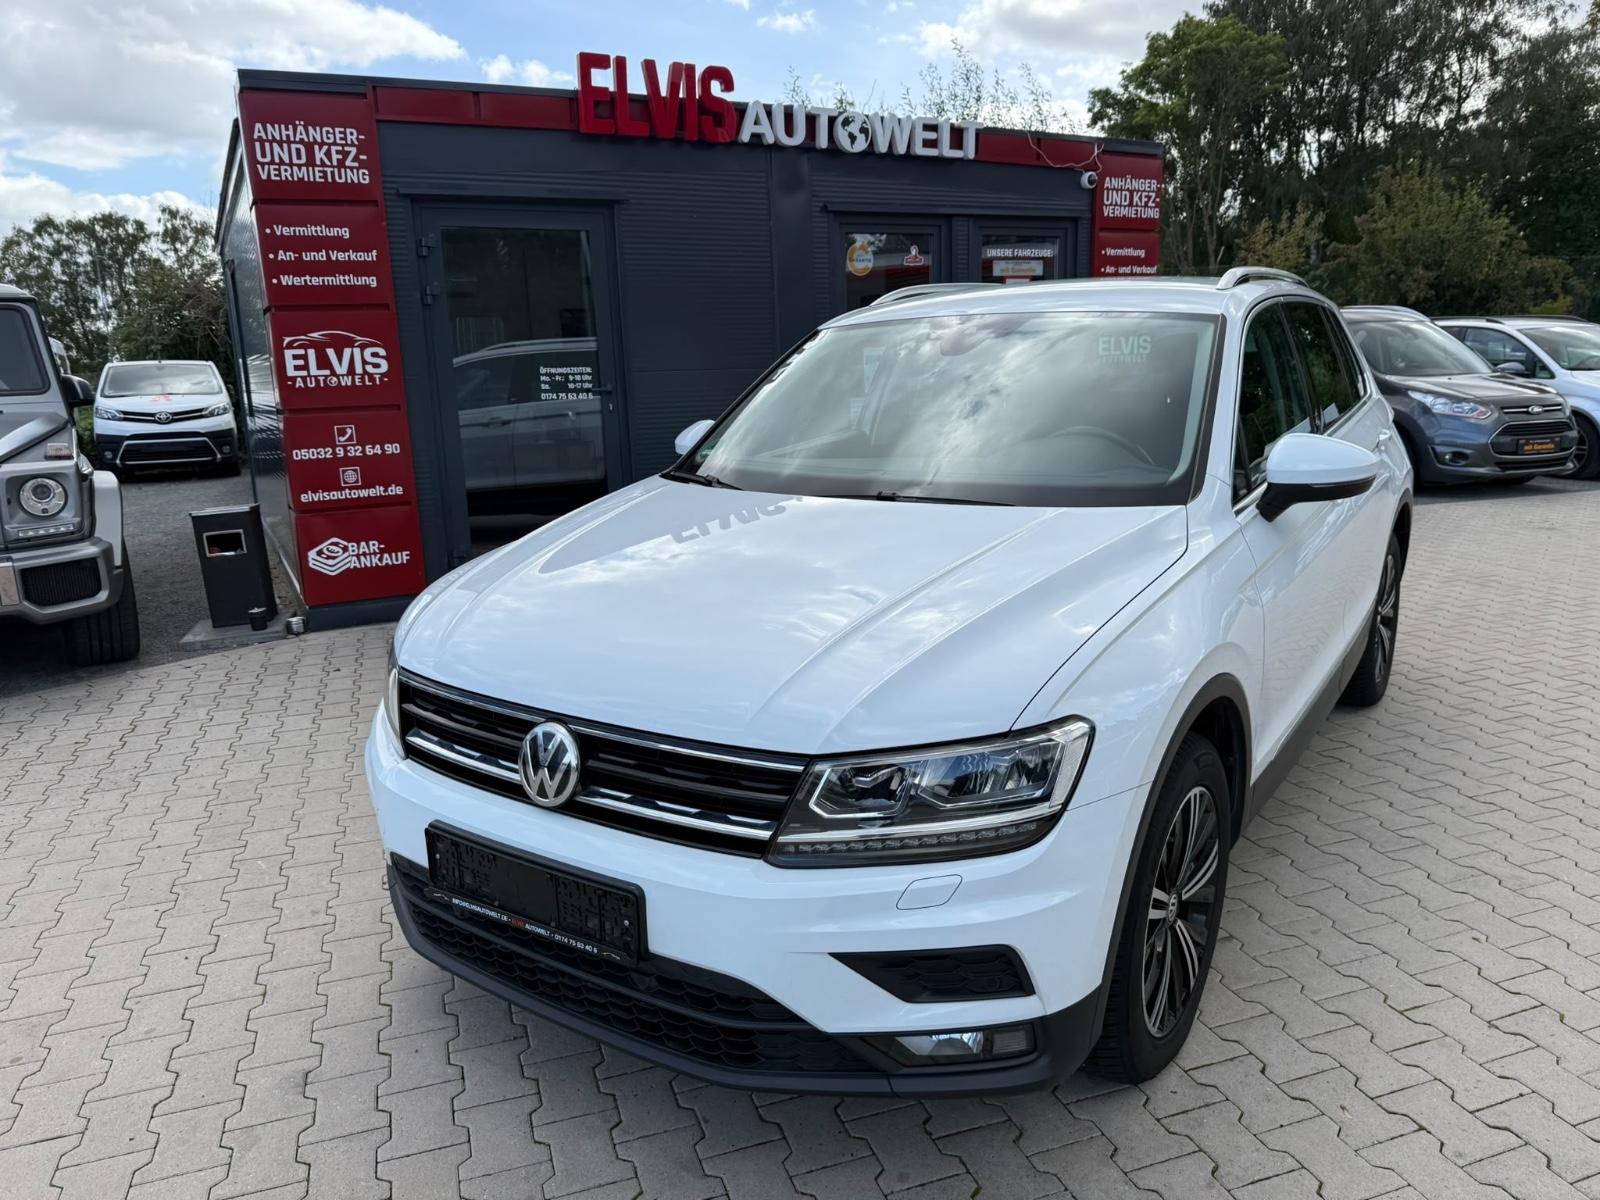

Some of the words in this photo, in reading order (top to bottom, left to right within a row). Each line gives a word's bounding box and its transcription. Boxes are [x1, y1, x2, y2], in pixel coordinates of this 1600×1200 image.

[577, 51, 737, 143] ELVIS
[253, 120, 366, 145] ANHÄNGER-
[255, 142, 307, 164] UND
[314, 145, 368, 167] KFZ-
[257, 164, 370, 184] VERMIETUNG
[1103, 175, 1160, 191] ANHÄNGER-
[1103, 190, 1129, 205] UND
[1133, 191, 1160, 207] KFZ-
[1103, 205, 1160, 219] VERMIETUNG
[273, 224, 350, 239] Vermittlung
[277, 250, 299, 261] An-
[302, 249, 327, 261] und
[329, 249, 378, 261] Verkauf
[986, 248, 1013, 257] UNSERE
[1106, 247, 1145, 258] Vermittlung
[1105, 265, 1117, 273] An-
[1118, 265, 1131, 273] und
[1132, 265, 1158, 273] Verkauf
[280, 274, 378, 288] Wertermittlung
[1098, 335, 1152, 355] ELVIS
[283, 346, 389, 377] ELVIS
[541, 392, 557, 400] 0174
[558, 392, 566, 400] 75
[578, 392, 587, 400] 40
[292, 446, 333, 461] 05032
[335, 446, 345, 458] 9
[347, 446, 363, 458] 32
[365, 444, 382, 456] 64
[384, 443, 400, 455] 90
[300, 484, 404, 503] elvisautowelt.de
[349, 540, 385, 555] BAR-
[349, 551, 411, 569] ANKAUF
[521, 724, 579, 805] VW
[554, 934, 568, 943] 0174
